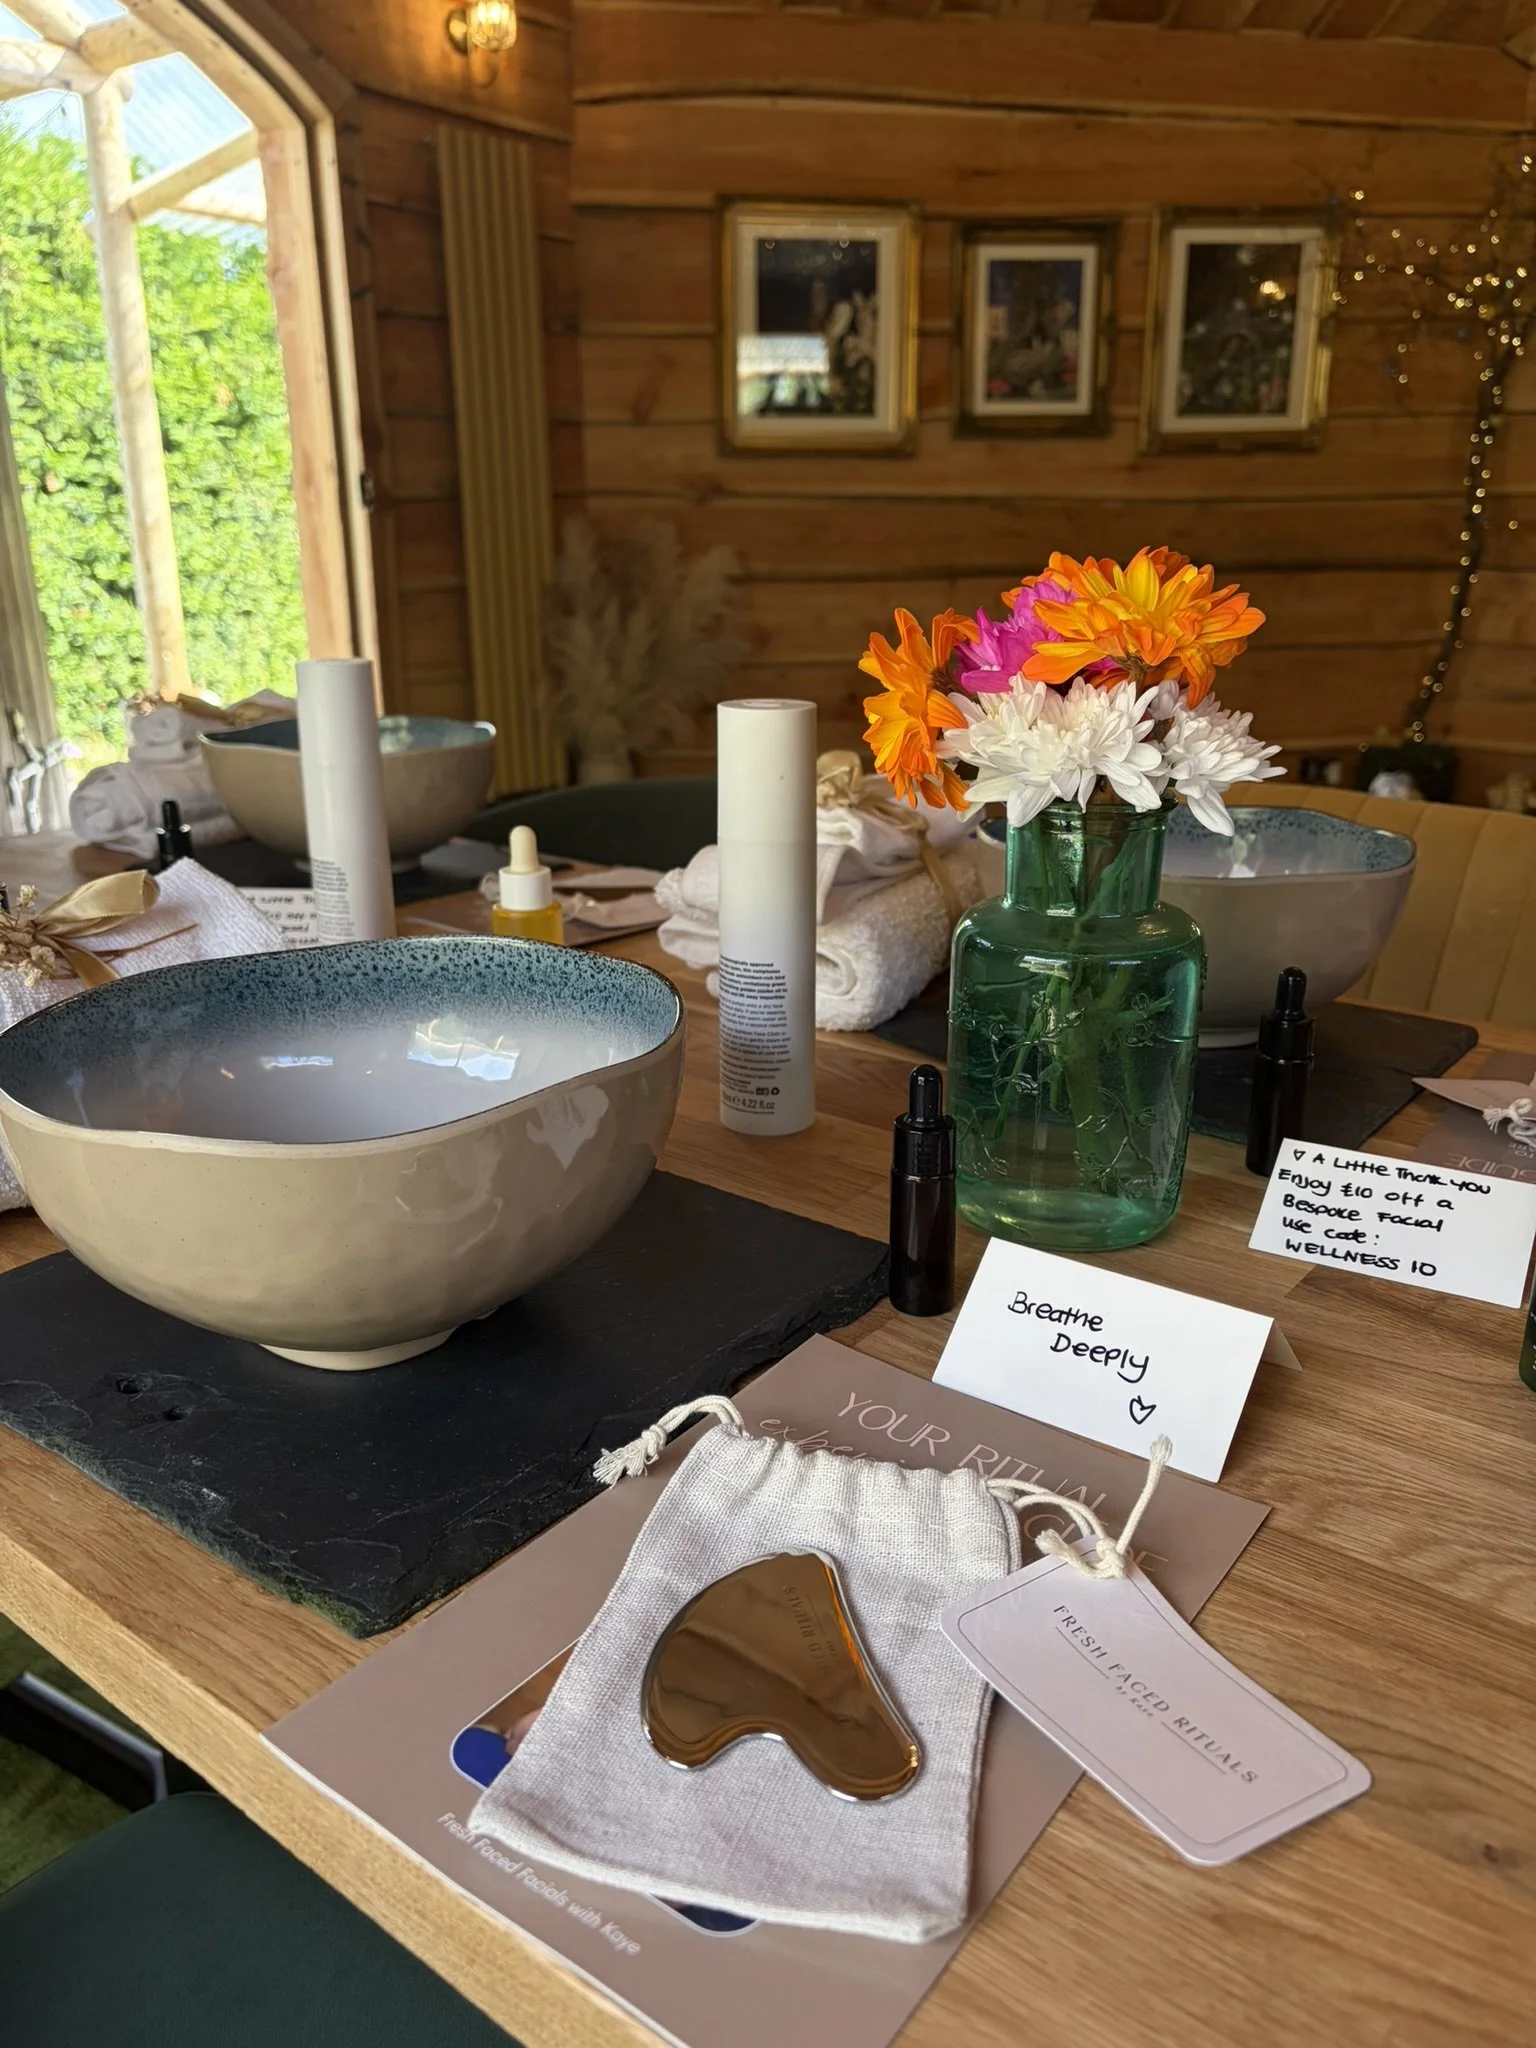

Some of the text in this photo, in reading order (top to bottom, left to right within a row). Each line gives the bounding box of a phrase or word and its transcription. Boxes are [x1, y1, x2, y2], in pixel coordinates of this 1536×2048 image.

[1278, 1168, 1455, 1210] Enjoy £10 off a
[1312, 1153, 1326, 1165] A
[1395, 1167, 1448, 1185] Thank
[1283, 1193, 1444, 1232] Bespoke Facial
[1285, 1238, 1437, 1277] WELLNESS 10
[1007, 1290, 1104, 1332] Breathe
[1049, 1333, 1150, 1384] Deeply
[837, 1391, 951, 1457] YOUR
[1052, 1604, 1259, 1784] FRESH FACED RITUALS
[437, 1811, 643, 1957] Fresh Faced Facials with Kaye
